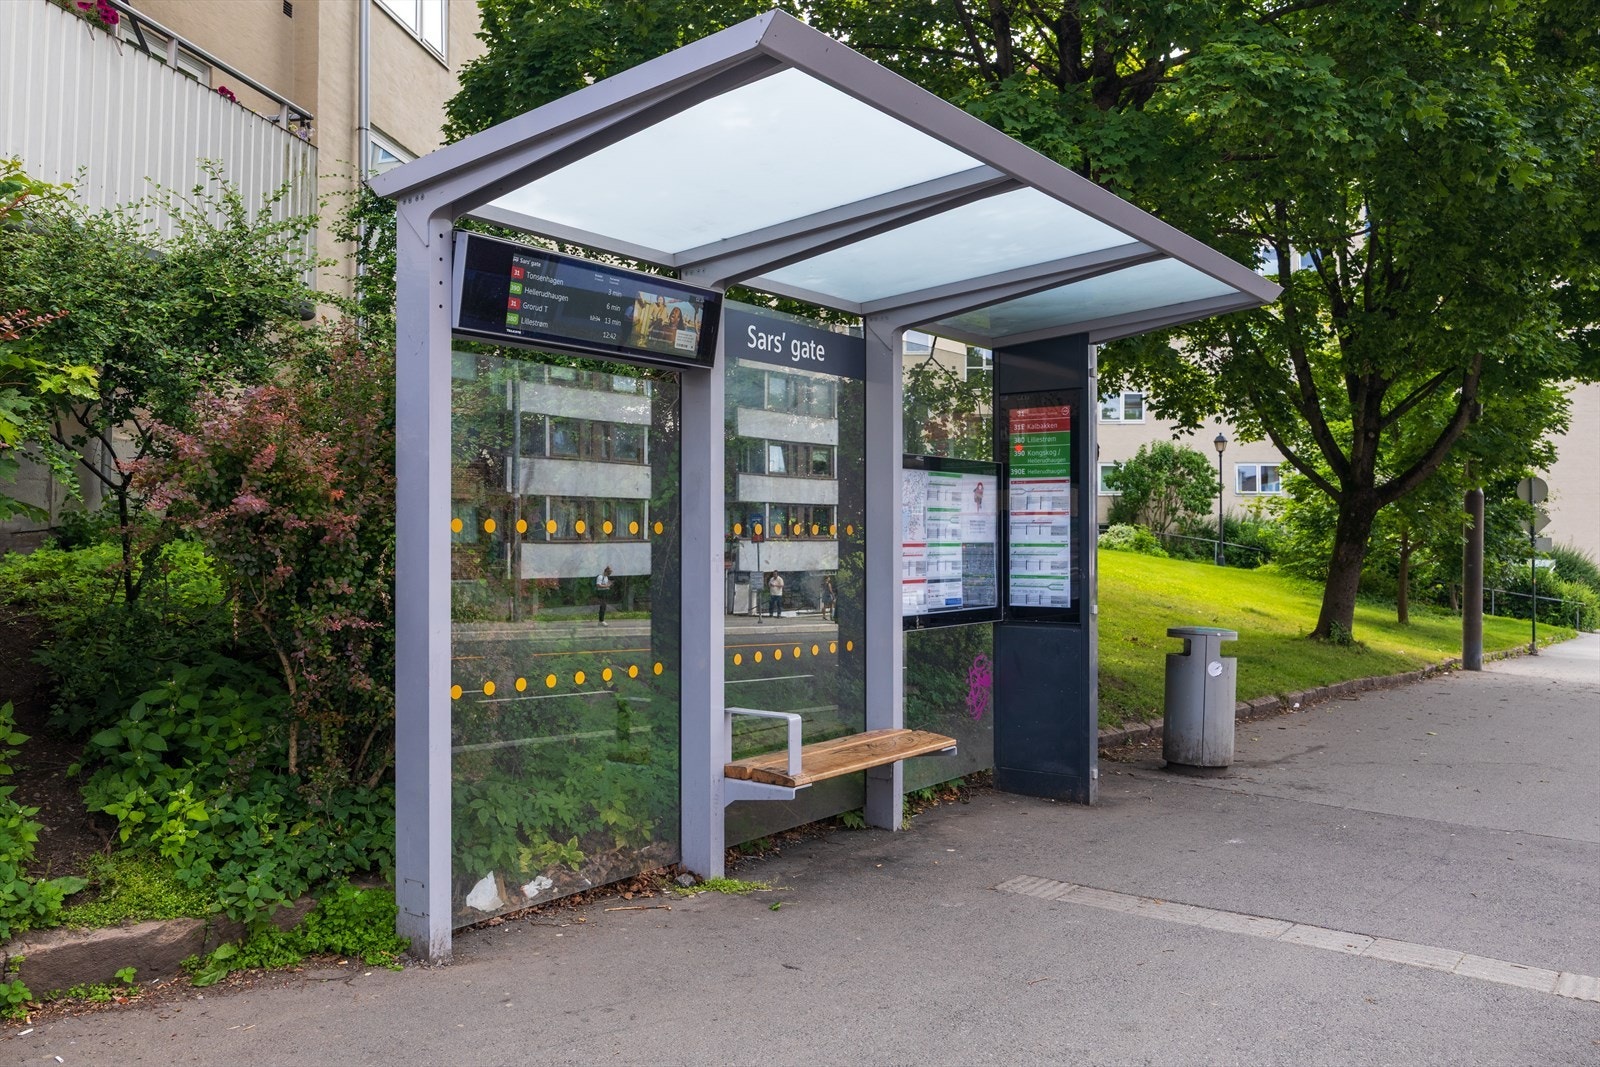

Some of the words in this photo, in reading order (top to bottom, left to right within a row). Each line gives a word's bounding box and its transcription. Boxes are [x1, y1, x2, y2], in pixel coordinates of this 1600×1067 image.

[526, 271, 564, 286] Tonsenhagen
[524, 286, 569, 302] Hellerudhaugen
[522, 301, 543, 312] Grorud
[611, 304, 621, 312] min
[521, 317, 548, 328] Lillestrøm
[605, 317, 611, 325] 13
[603, 331, 617, 340] 12:42
[747, 324, 786, 353] Sars'
[791, 338, 825, 362] gate
[1027, 449, 1057, 458] Kongskog
